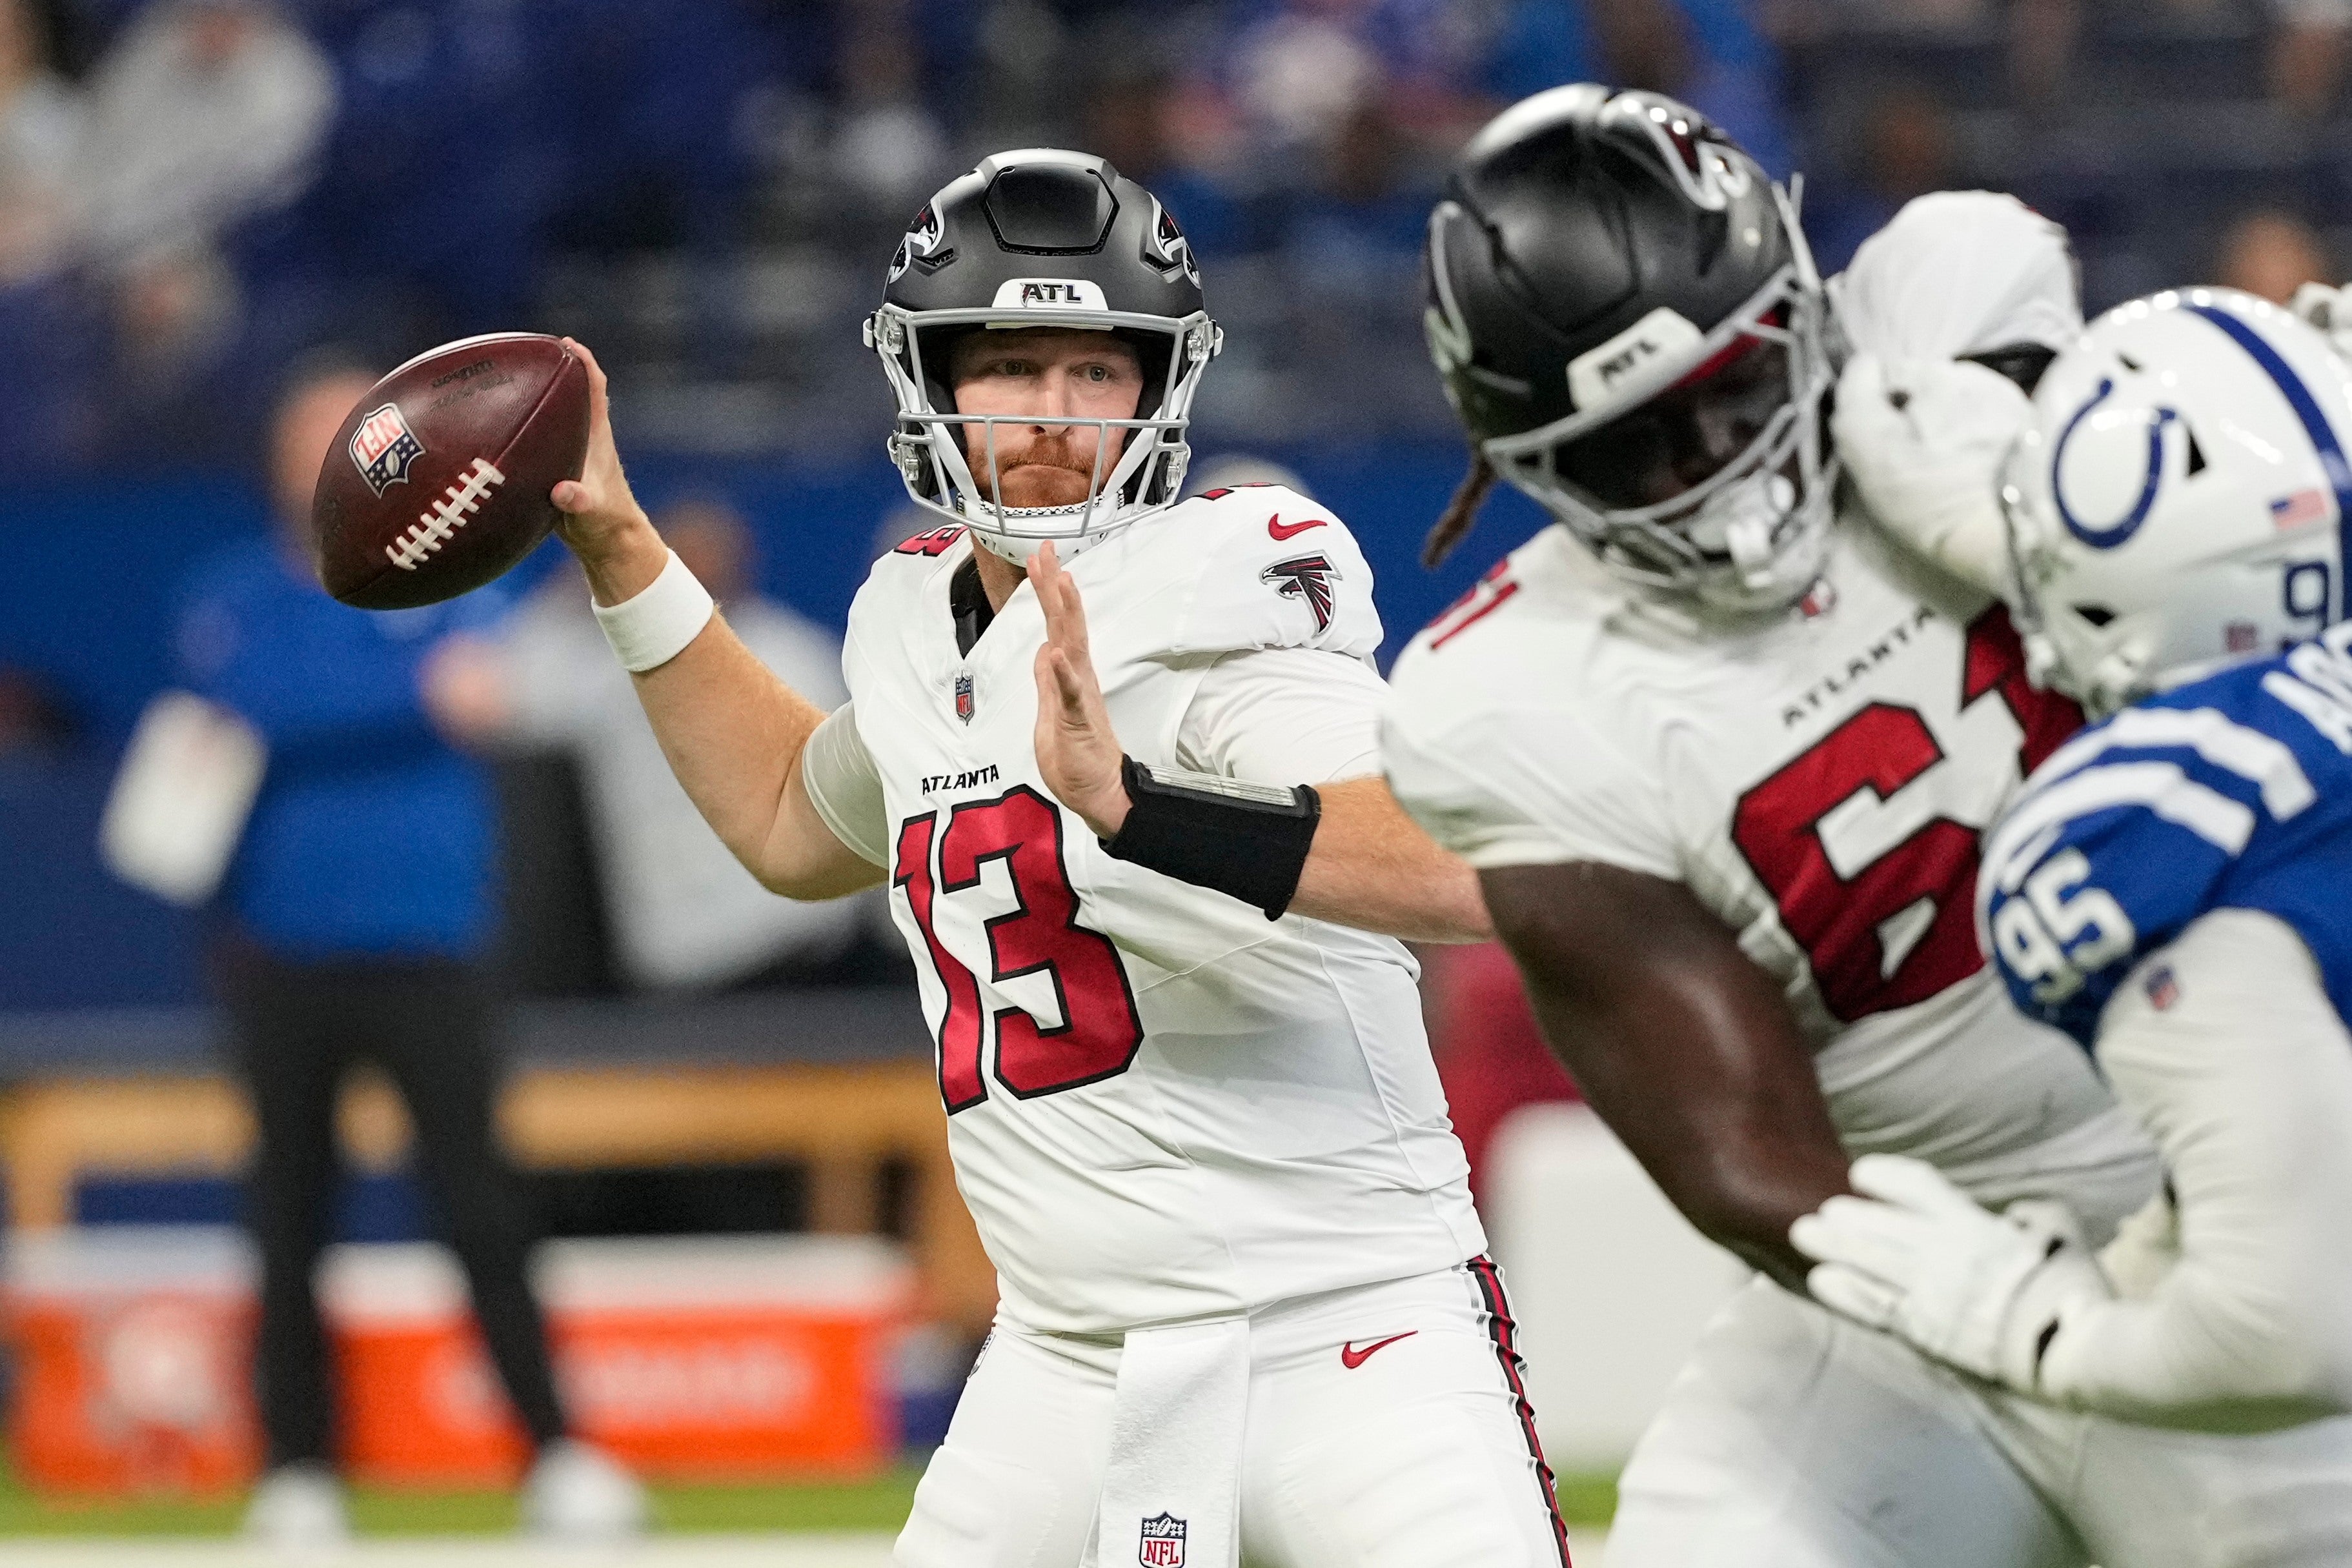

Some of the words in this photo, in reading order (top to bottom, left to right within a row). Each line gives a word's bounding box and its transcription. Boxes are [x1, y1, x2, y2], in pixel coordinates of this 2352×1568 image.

[1020, 283, 1082, 308] ATL
[356, 412, 401, 463] NFL
[1783, 605, 1935, 728] ATLANTA
[922, 764, 999, 796] ATLANTA
[893, 783, 1145, 1116] 13
[1994, 846, 2136, 1003] 95
[1143, 1540, 1179, 1567] NFL
